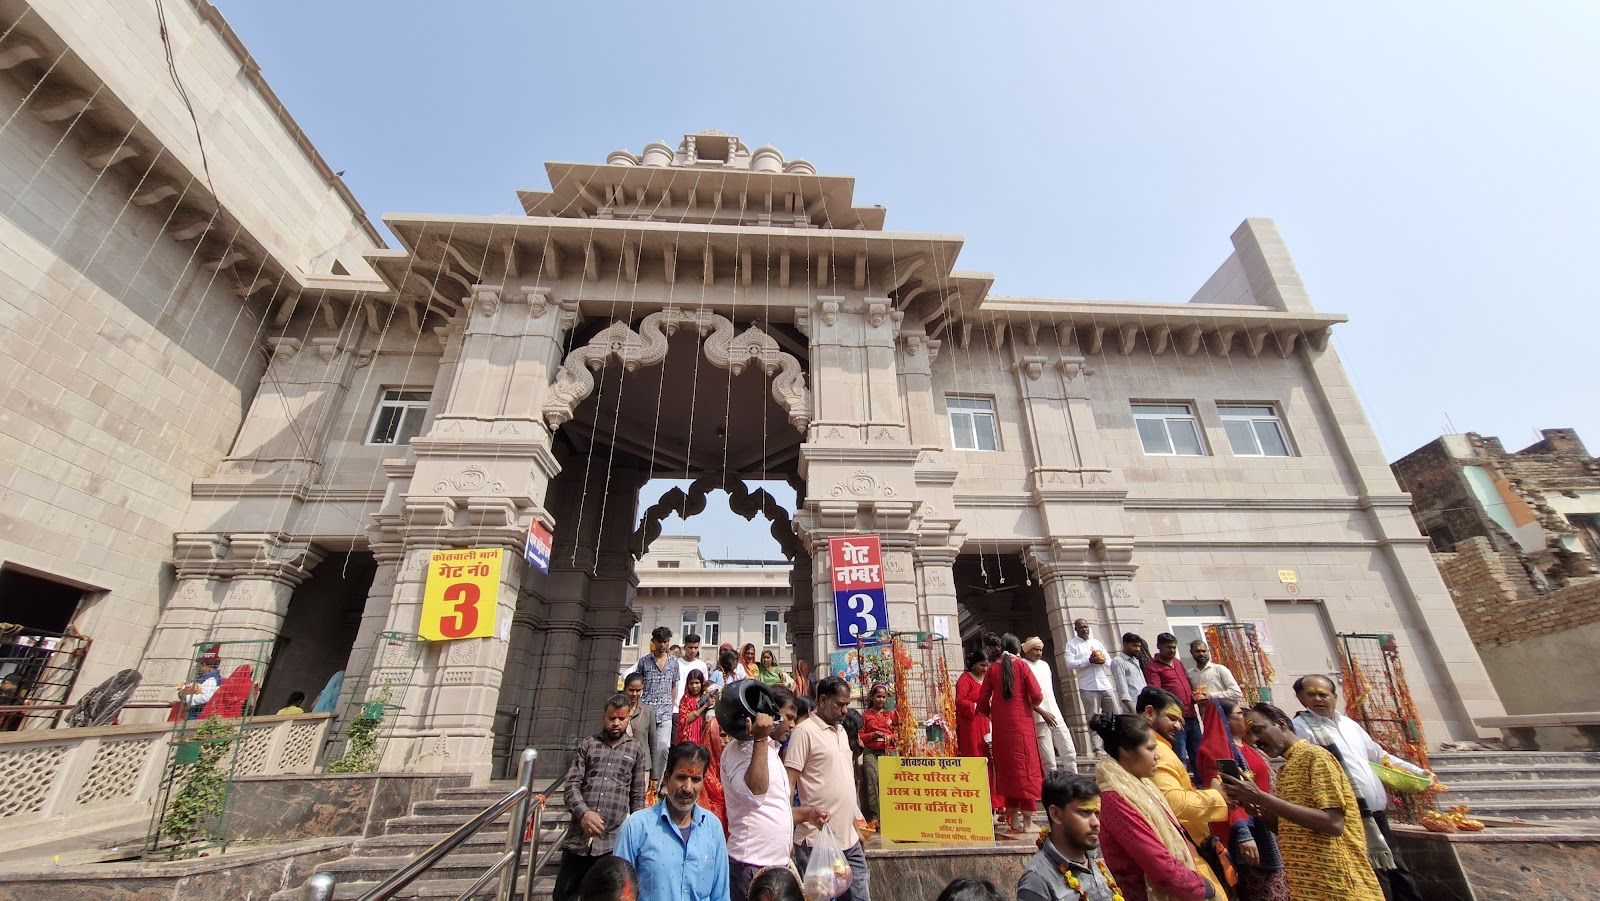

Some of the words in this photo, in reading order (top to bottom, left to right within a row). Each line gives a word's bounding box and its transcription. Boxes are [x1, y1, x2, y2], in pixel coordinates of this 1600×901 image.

[432, 551, 477, 561] कोतवाली
[479, 549, 499, 559] मार्ग
[841, 541, 870, 565] गेट
[438, 563, 465, 578] गेट
[834, 564, 880, 585] नम्बर
[439, 582, 481, 638] 3
[847, 593, 878, 638] 3
[900, 758, 936, 767] आवश्यक
[938, 758, 962, 770] सूचना
[893, 771, 921, 782] मंदिर
[922, 771, 956, 783] परिसर
[959, 772, 971, 783] में
[887, 787, 911, 796] अस्त्र
[912, 788, 921, 796] व
[923, 788, 948, 797] शस्त्र
[950, 786, 981, 798] लेकर
[893, 802, 922, 811] जाना
[924, 801, 957, 813] वर्जित
